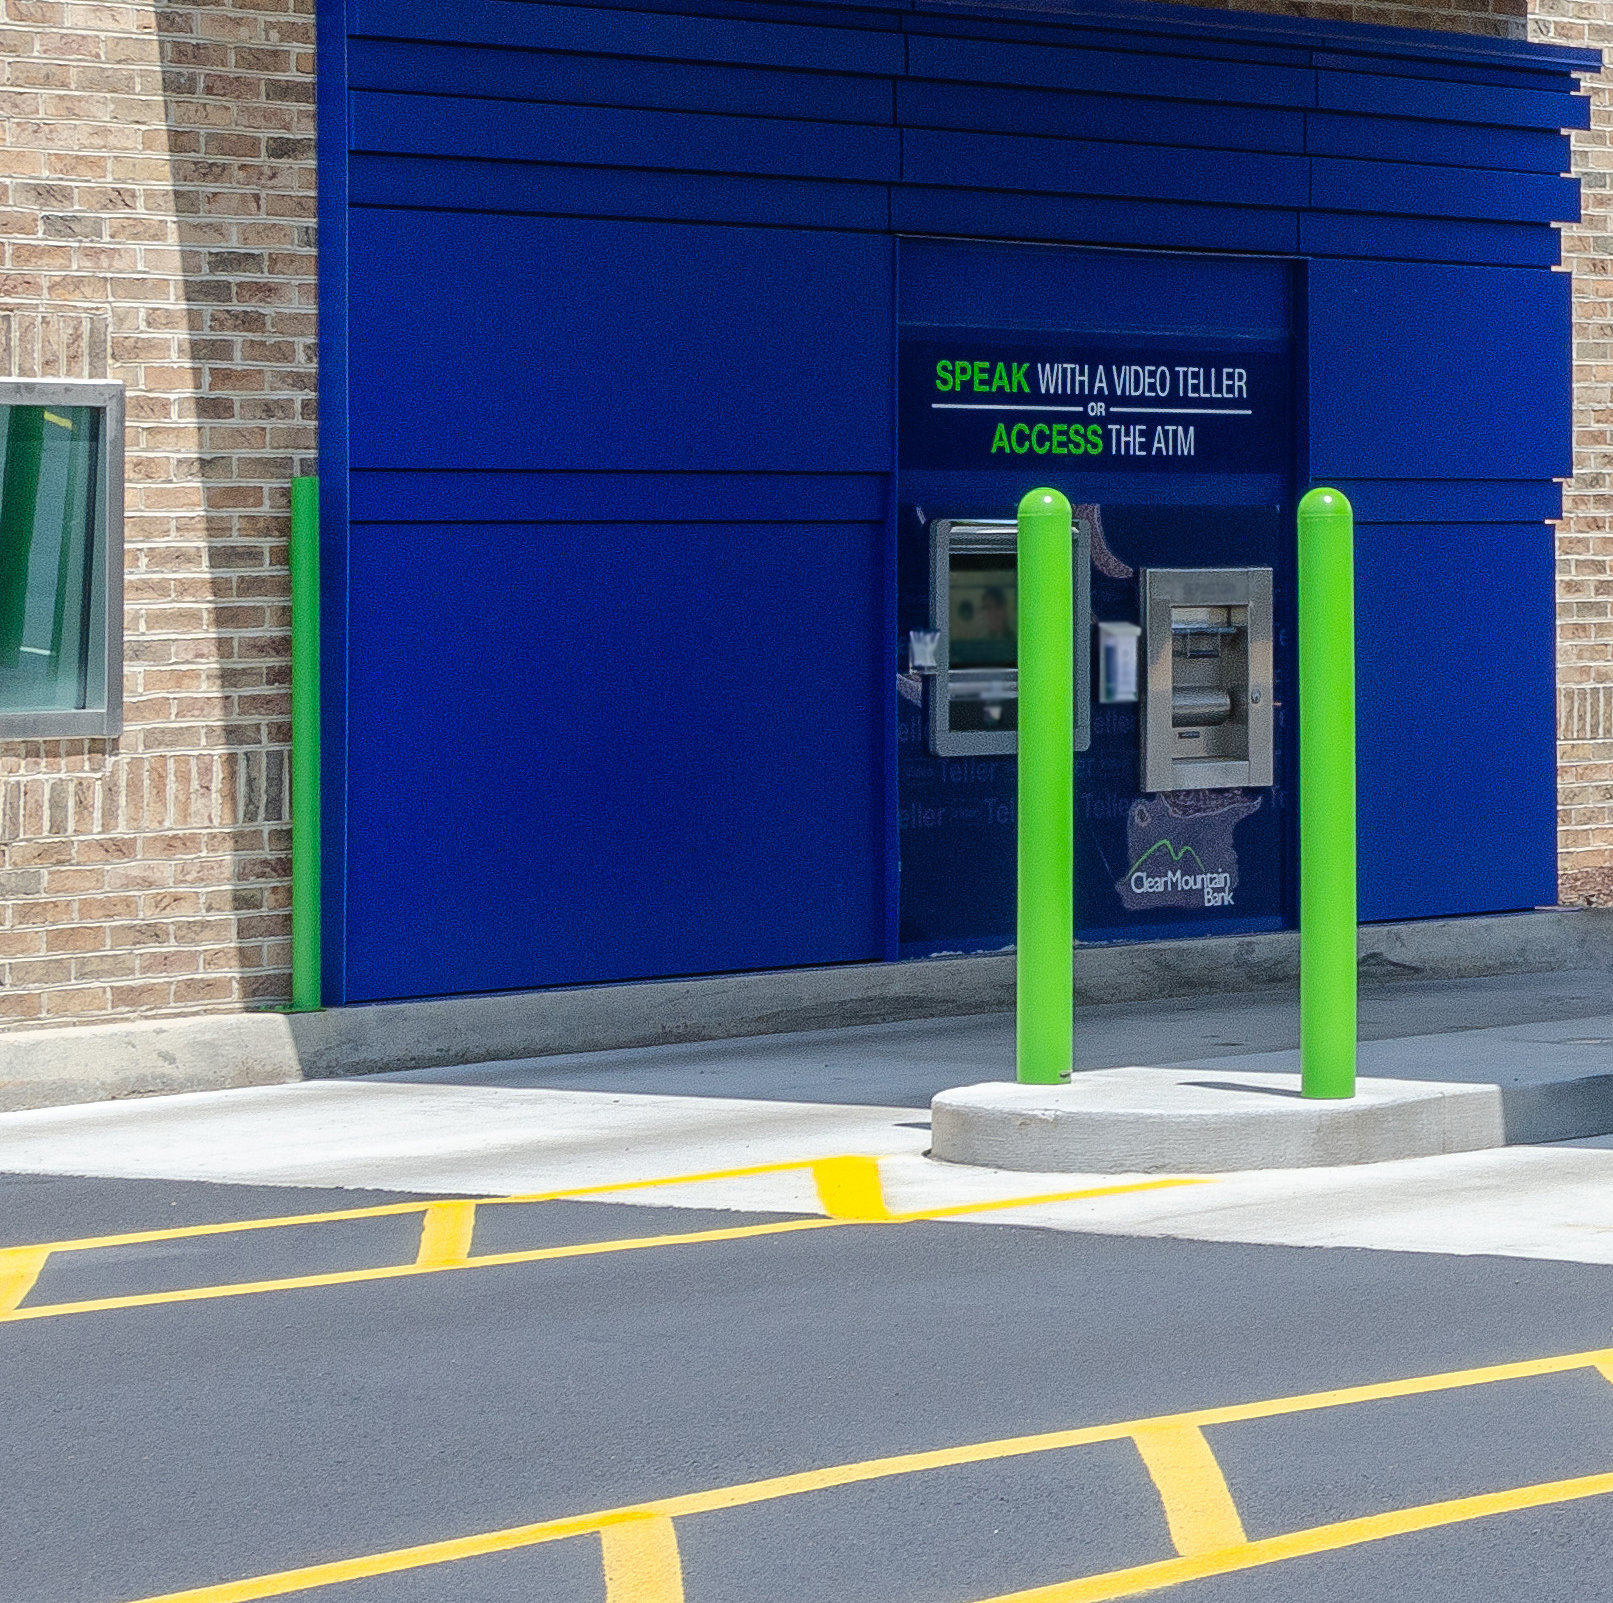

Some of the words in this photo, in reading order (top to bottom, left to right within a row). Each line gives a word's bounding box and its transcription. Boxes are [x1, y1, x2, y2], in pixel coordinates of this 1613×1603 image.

[935, 359, 1031, 393] SPEAK
[1037, 363, 1089, 395] WITH
[1093, 364, 1108, 396] A
[1112, 365, 1171, 397] VIDEO
[1175, 366, 1248, 398] TELLER
[1087, 401, 1106, 417] OR
[991, 422, 1103, 455] ACCESS
[1107, 424, 1147, 456] THE
[1151, 425, 1196, 456] ATM
[898, 802, 947, 829] eller
[1130, 868, 1231, 894] ClearMountain
[1204, 886, 1235, 907] Bank
